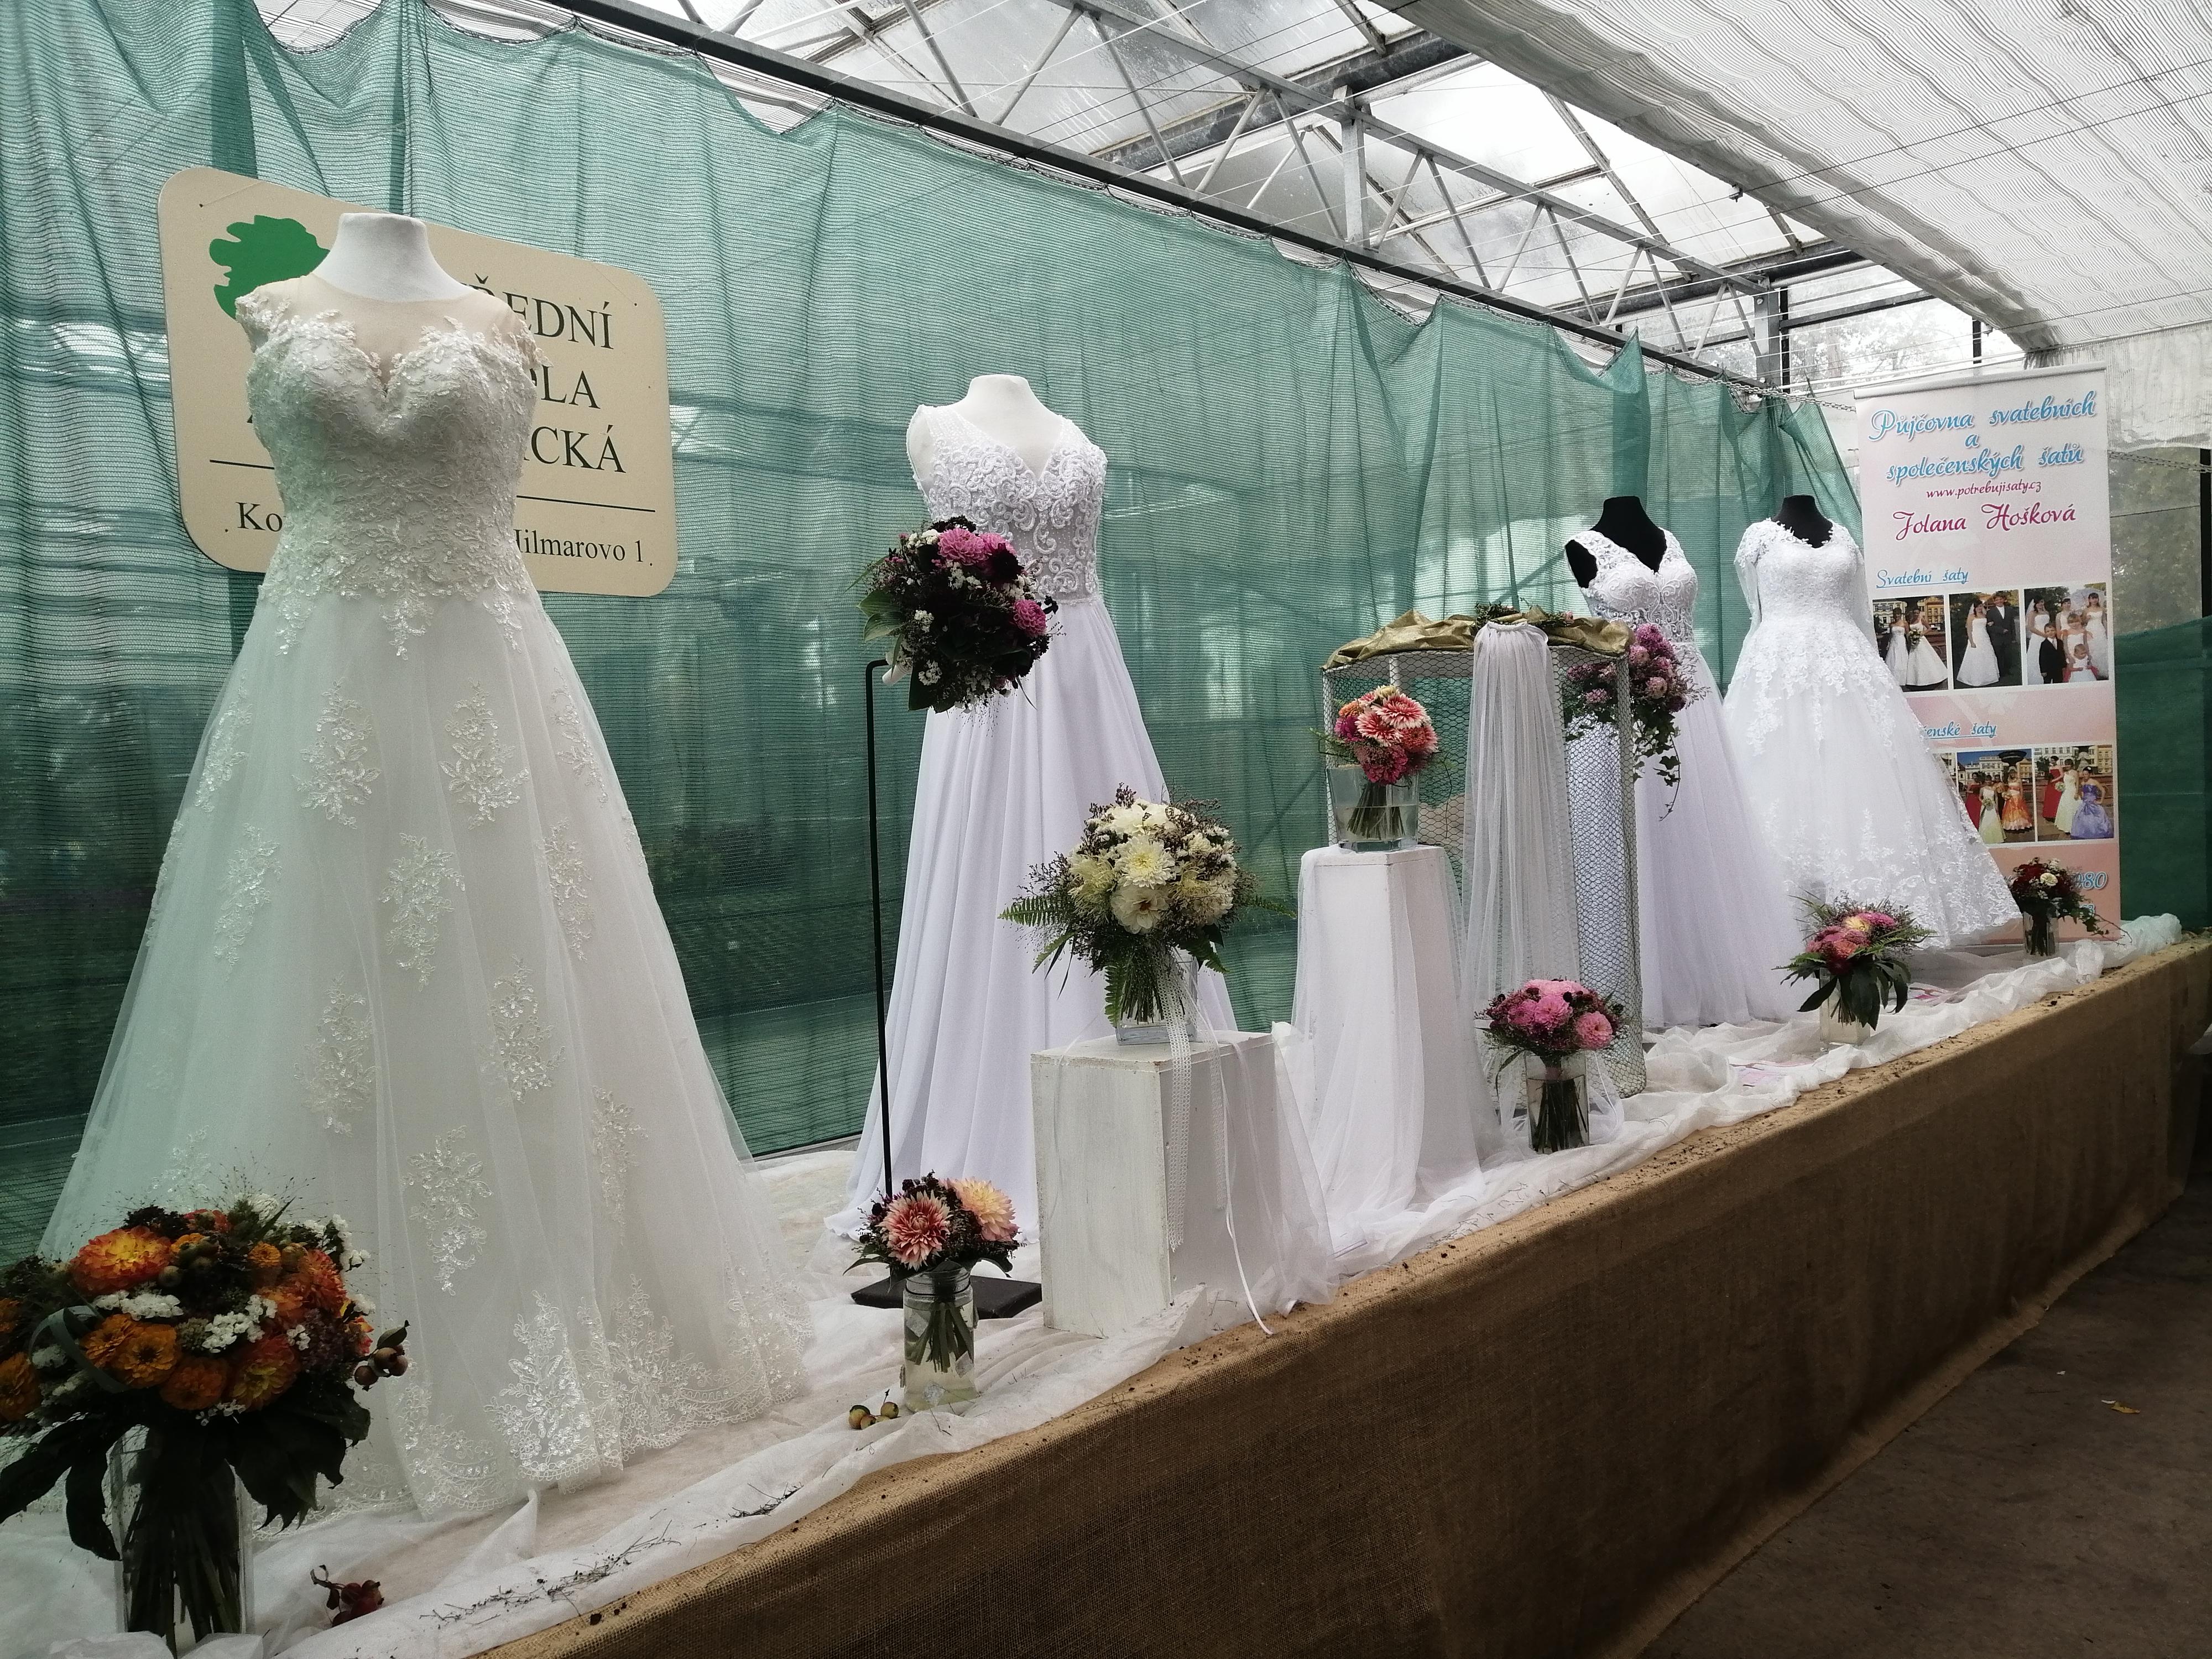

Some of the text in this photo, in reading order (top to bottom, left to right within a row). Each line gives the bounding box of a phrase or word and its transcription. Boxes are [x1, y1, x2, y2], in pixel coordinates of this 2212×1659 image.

[1868, 390, 2096, 441] Půjčovna svatebních
[1964, 434, 1979, 448] a
[1886, 443, 2084, 485] společenských šatů
[1926, 479, 2042, 499] www.potrebujisaty.cz
[235, 502, 286, 532] Ko
[1892, 502, 2077, 541] Jolana Hošková
[1876, 567, 1969, 588] Svatební šaty
[1923, 721, 1996, 738] enské šaty
